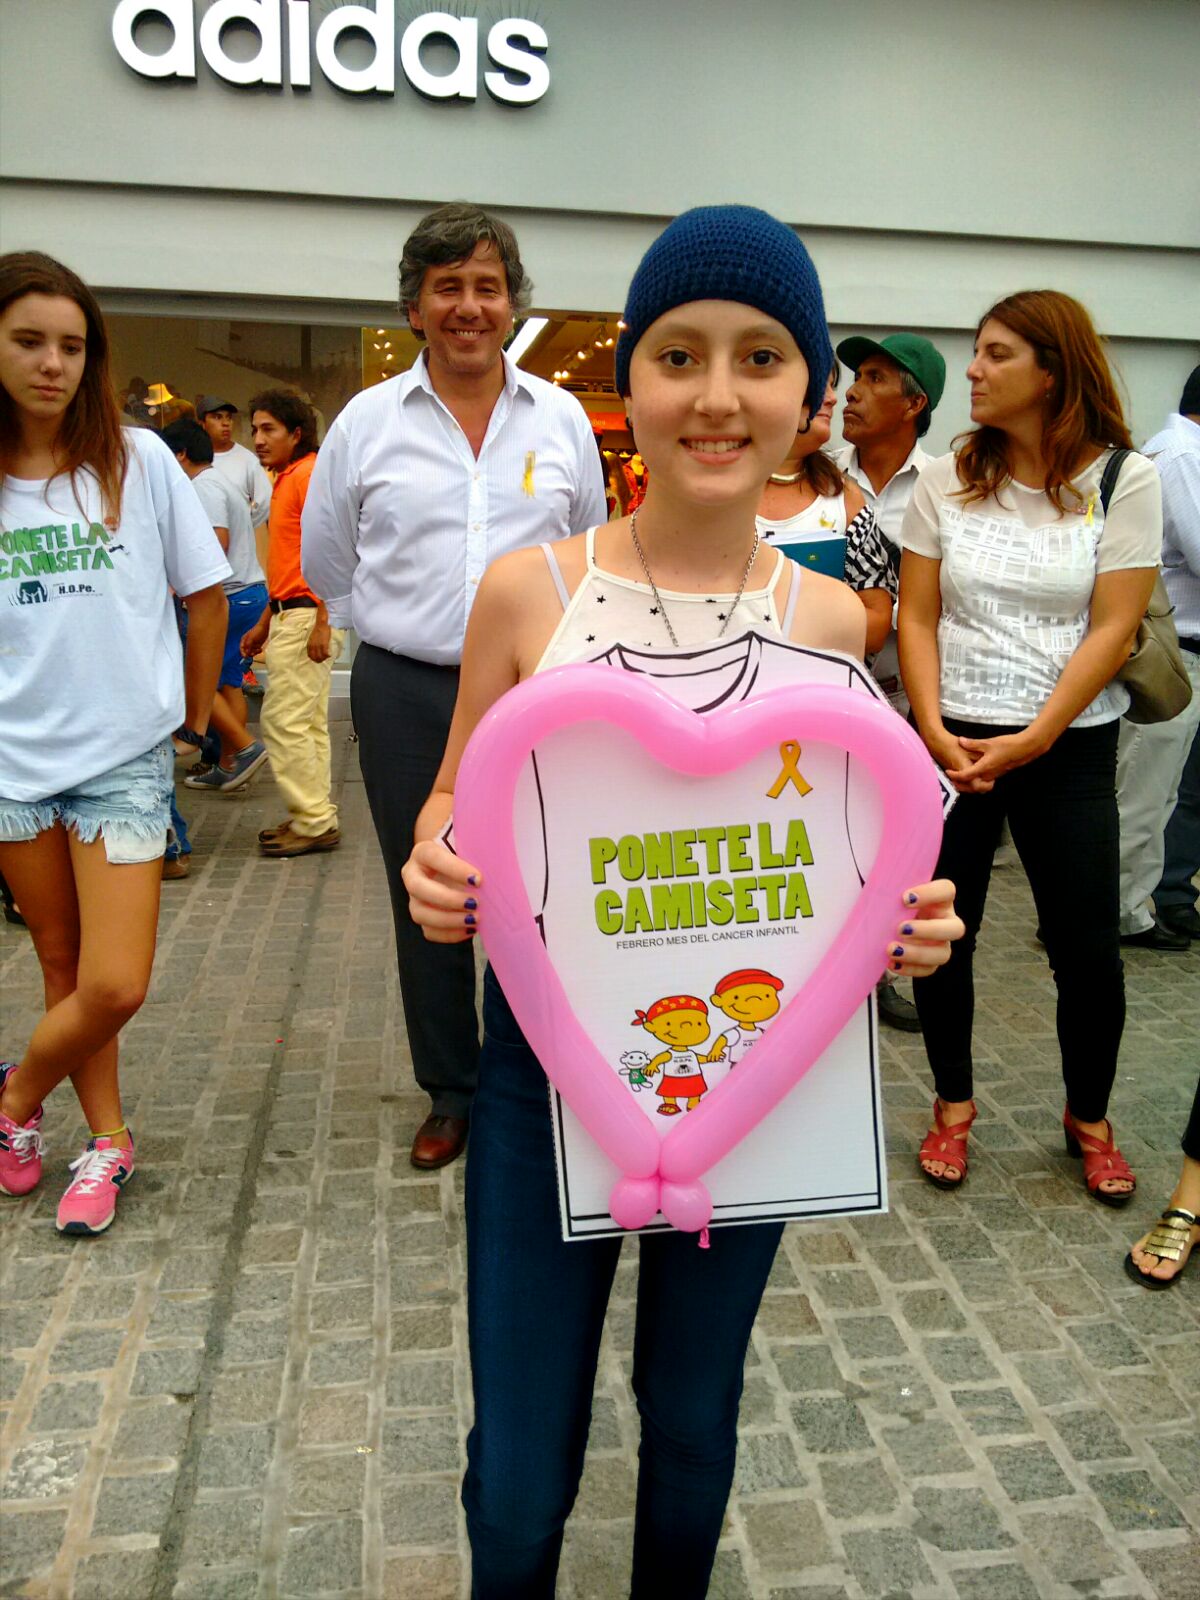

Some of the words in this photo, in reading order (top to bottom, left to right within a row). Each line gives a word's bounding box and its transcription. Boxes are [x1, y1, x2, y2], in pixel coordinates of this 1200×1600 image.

[111, 0, 551, 107] adidas
[0, 525, 68, 556] ONETE
[71, 522, 111, 546] LA
[589, 824, 753, 884] PONETE
[757, 819, 814, 869] LA
[594, 872, 814, 935] CAMISETA
[616, 937, 664, 950] FEBRERO
[666, 935, 688, 945] MES
[690, 933, 709, 944] DEL
[711, 929, 754, 942] CANCER
[756, 926, 799, 937] INFANTIL
